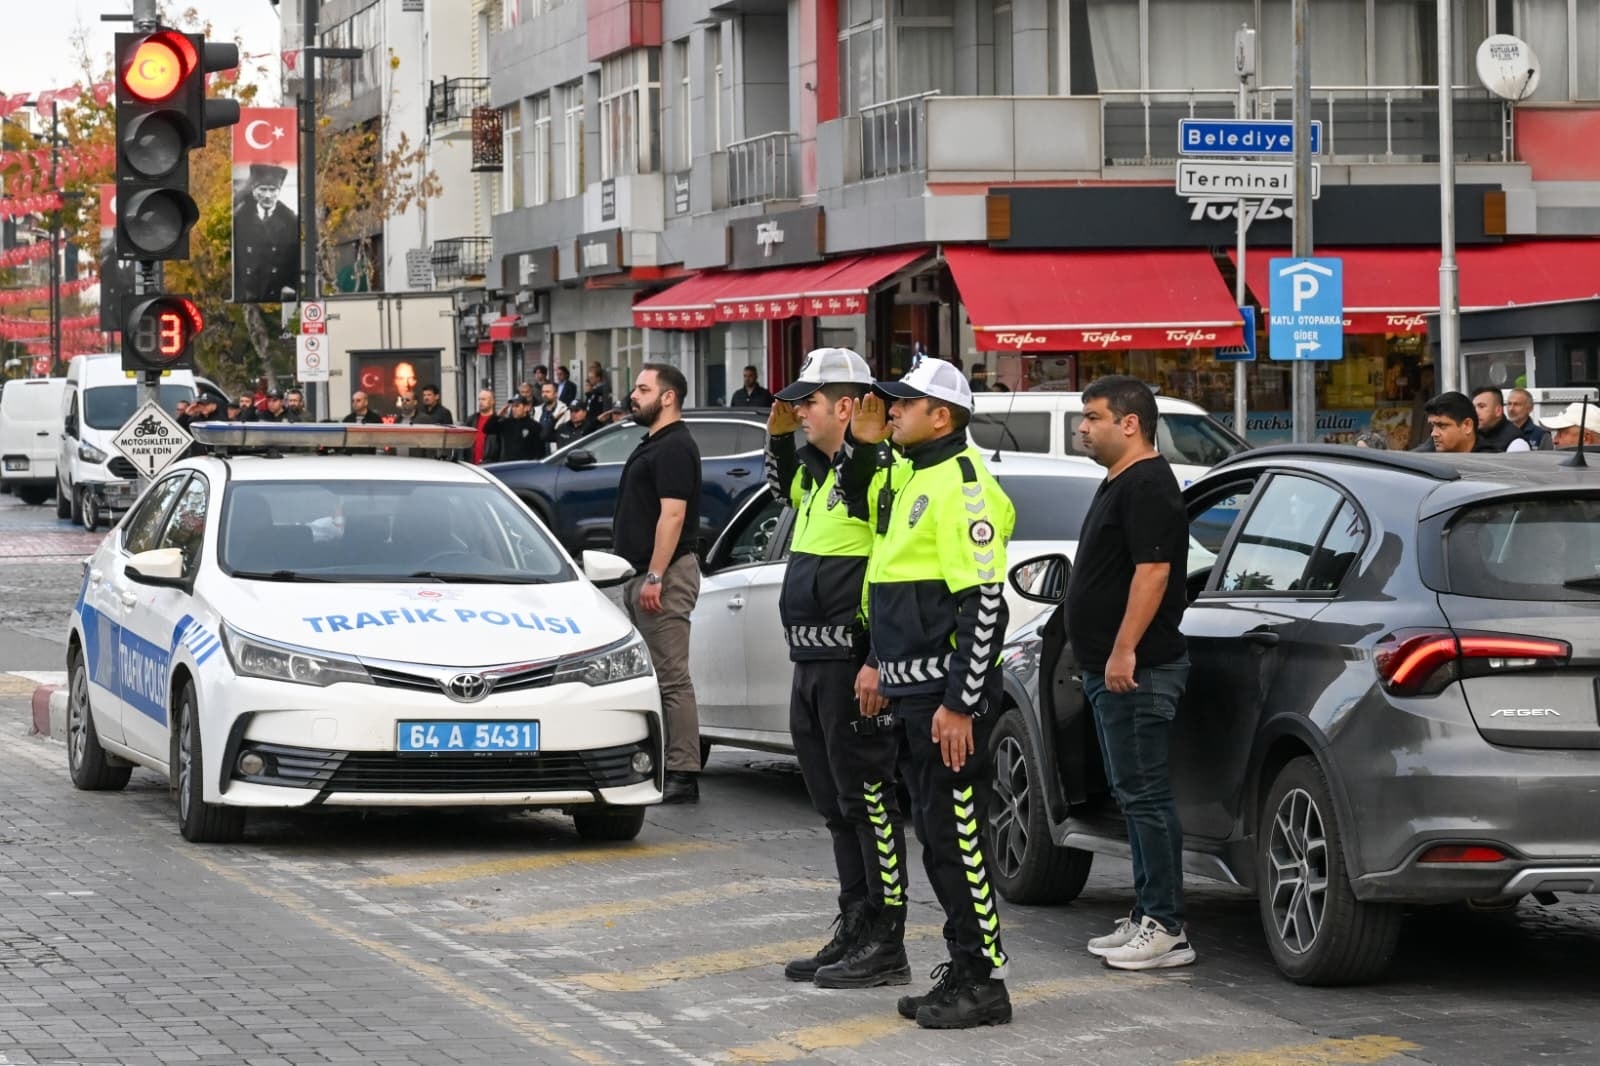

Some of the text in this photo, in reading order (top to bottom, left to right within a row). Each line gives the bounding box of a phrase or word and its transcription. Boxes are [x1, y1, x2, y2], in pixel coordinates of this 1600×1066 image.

[1188, 129, 1291, 150] Belediye
[1186, 171, 1287, 188] Terminal
[1293, 274, 1319, 312] P
[309, 308, 318, 317] 20
[1271, 316, 1294, 325] KATLI
[1298, 315, 1341, 325] OTOPARKA
[1386, 314, 1427, 331] Tuğb
[161, 314, 181, 353] 3
[1294, 329, 1318, 340] GİDER
[121, 438, 183, 447] MOTOSİKLETLERİ
[132, 446, 172, 455] FARK EDİN
[302, 607, 581, 635] TRAFİK POLİSİ
[410, 725, 531, 748] 64 A 5431
